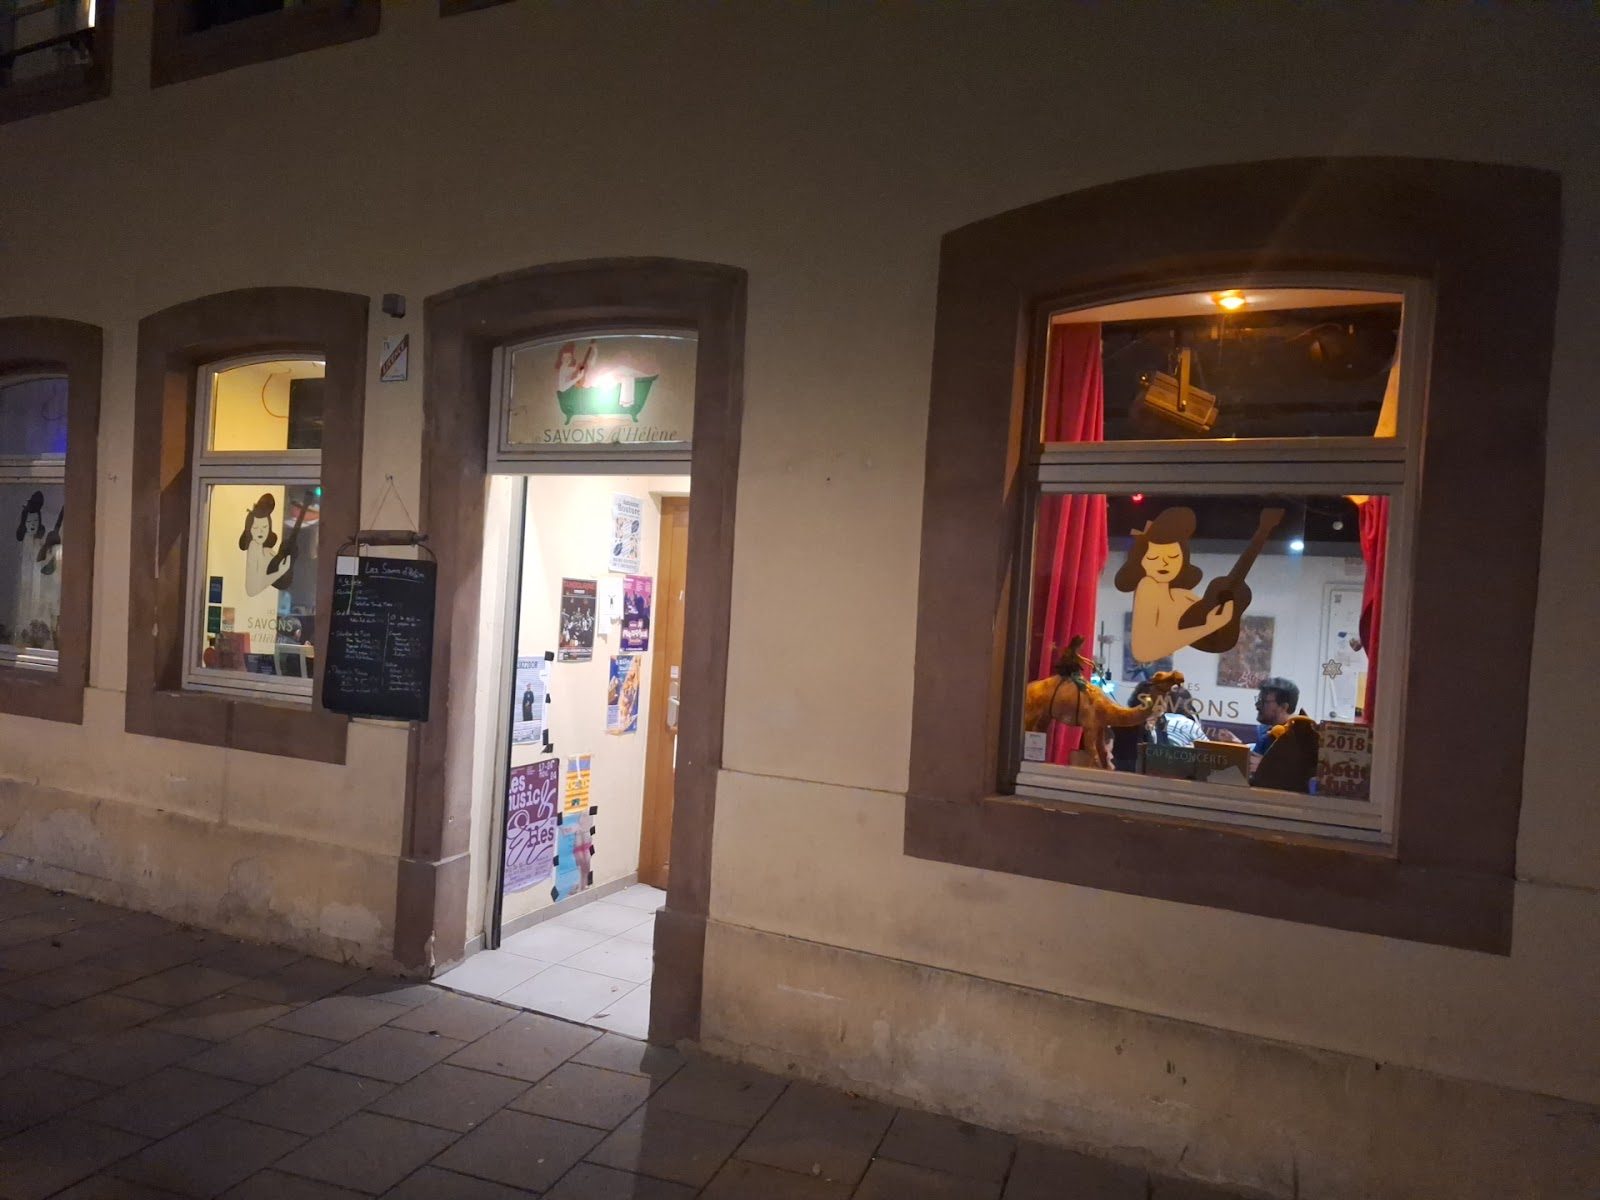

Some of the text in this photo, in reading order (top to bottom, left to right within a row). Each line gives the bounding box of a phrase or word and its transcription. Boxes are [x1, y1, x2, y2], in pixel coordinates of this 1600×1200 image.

[543, 426, 678, 443] SAVONS d'Hélène
[247, 617, 294, 633] SAVONS
[1187, 682, 1201, 692] ES
[1136, 693, 1240, 719] SAVONS
[1326, 735, 1365, 751] 2018
[509, 775, 526, 794] es
